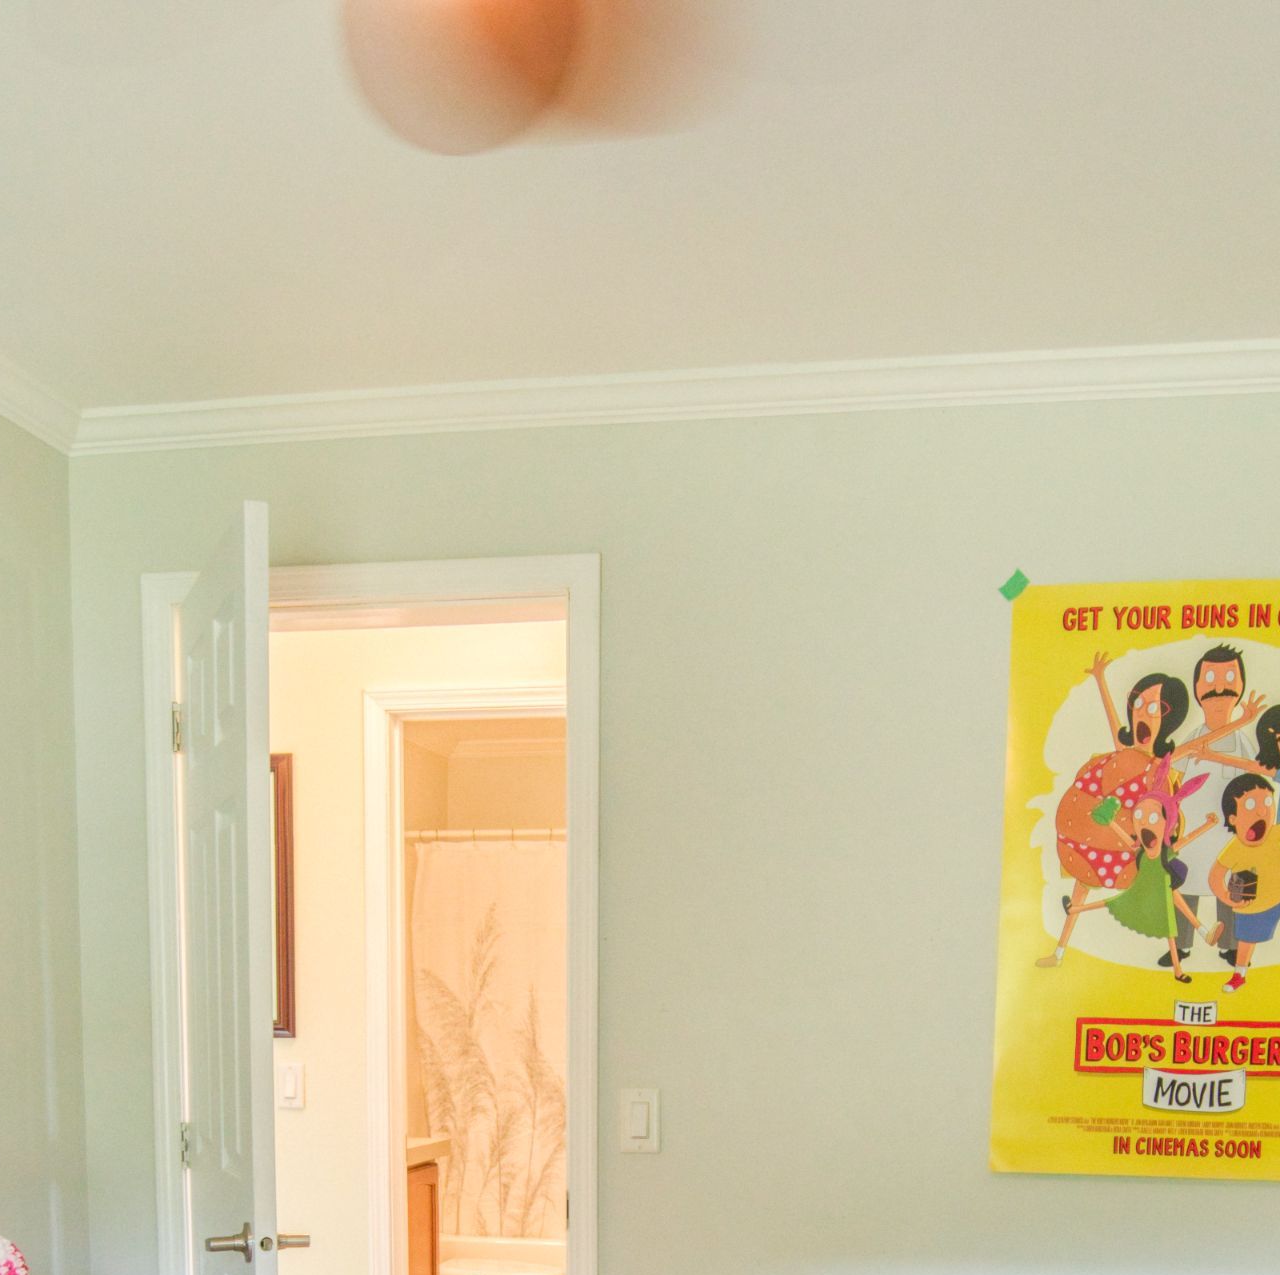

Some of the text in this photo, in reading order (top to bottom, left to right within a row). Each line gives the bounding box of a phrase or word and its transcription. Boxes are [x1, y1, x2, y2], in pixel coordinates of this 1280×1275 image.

[1063, 606, 1102, 631] GET
[1113, 606, 1171, 630] YOUR
[1181, 603, 1239, 629] BUNS
[1248, 603, 1271, 629] IN
[1179, 1004, 1212, 1023] THE
[1085, 1029, 1166, 1063] BOB'S
[1152, 1077, 1233, 1109] MOVIE
[1113, 1136, 1262, 1159] IN CINEMAS SOON
